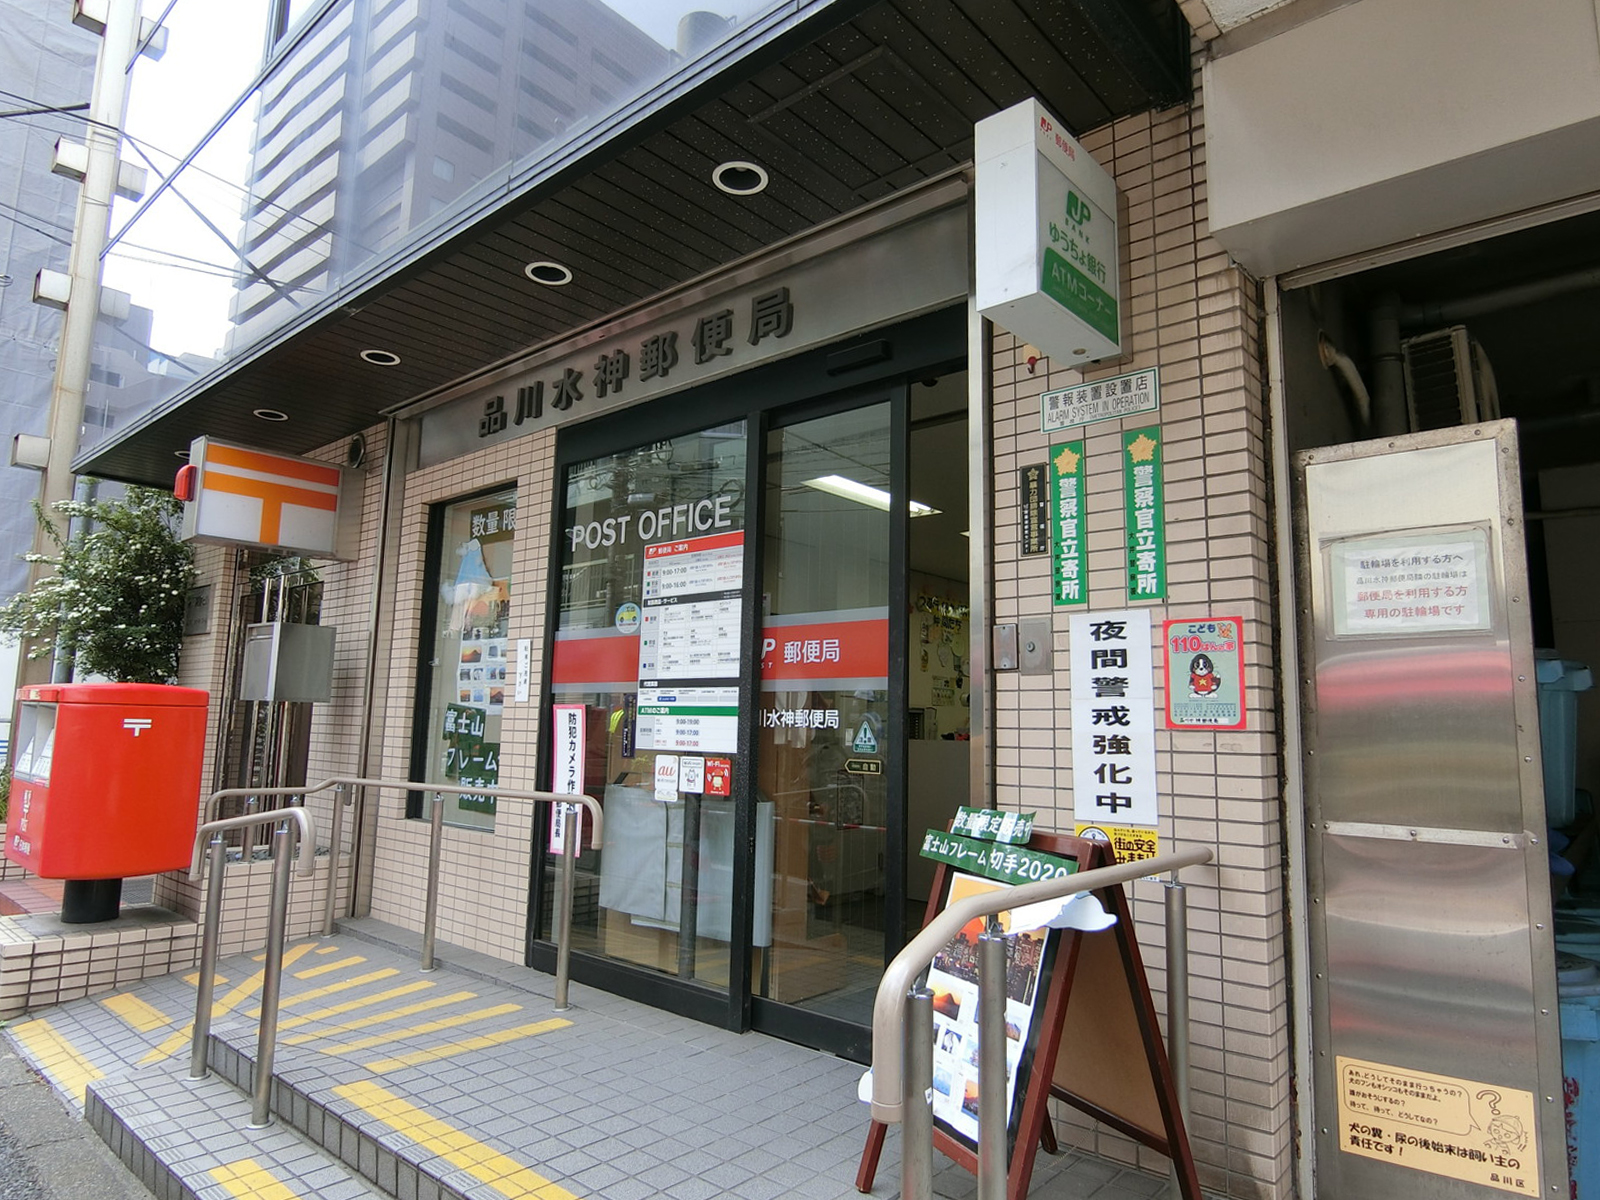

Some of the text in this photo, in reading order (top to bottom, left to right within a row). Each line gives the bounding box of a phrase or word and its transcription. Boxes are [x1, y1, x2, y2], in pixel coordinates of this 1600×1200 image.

[1054, 133, 1077, 162] 郵便局
[1064, 216, 1091, 244] BANK
[1049, 221, 1107, 285] ゆうちょ銀行
[1051, 262, 1112, 317] ATMコーナー
[478, 286, 795, 438] 品川水神郵便局
[1047, 391, 1150, 423] ALARM SYSTEM IN OPERATION
[1048, 375, 1148, 411] 警報装置設置店
[472, 508, 516, 537] 数量限
[571, 496, 732, 552] POST OFFICE
[1133, 465, 1158, 595] 警察官立寄所
[1058, 477, 1079, 600] 警察官立寄所
[662, 567, 687, 576] 9:00-17:00
[1360, 554, 1464, 569] 駐輪場を利用する方へ
[1357, 585, 1468, 602] 郵便局を利用する方
[1364, 604, 1465, 619] 専用の駐輪場です
[1188, 624, 1216, 634] こども
[783, 639, 840, 664] 郵便局
[1171, 635, 1235, 653] 110ばんの家
[445, 708, 484, 738] 富士山
[1089, 620, 1133, 814] 夜間警戒強化中
[447, 747, 500, 771] フレーム
[658, 765, 676, 777] au
[1114, 837, 1156, 853] 街の安全
[1349, 1134, 1404, 1156] 責任です！
[1490, 1172, 1525, 1188] 品川区
